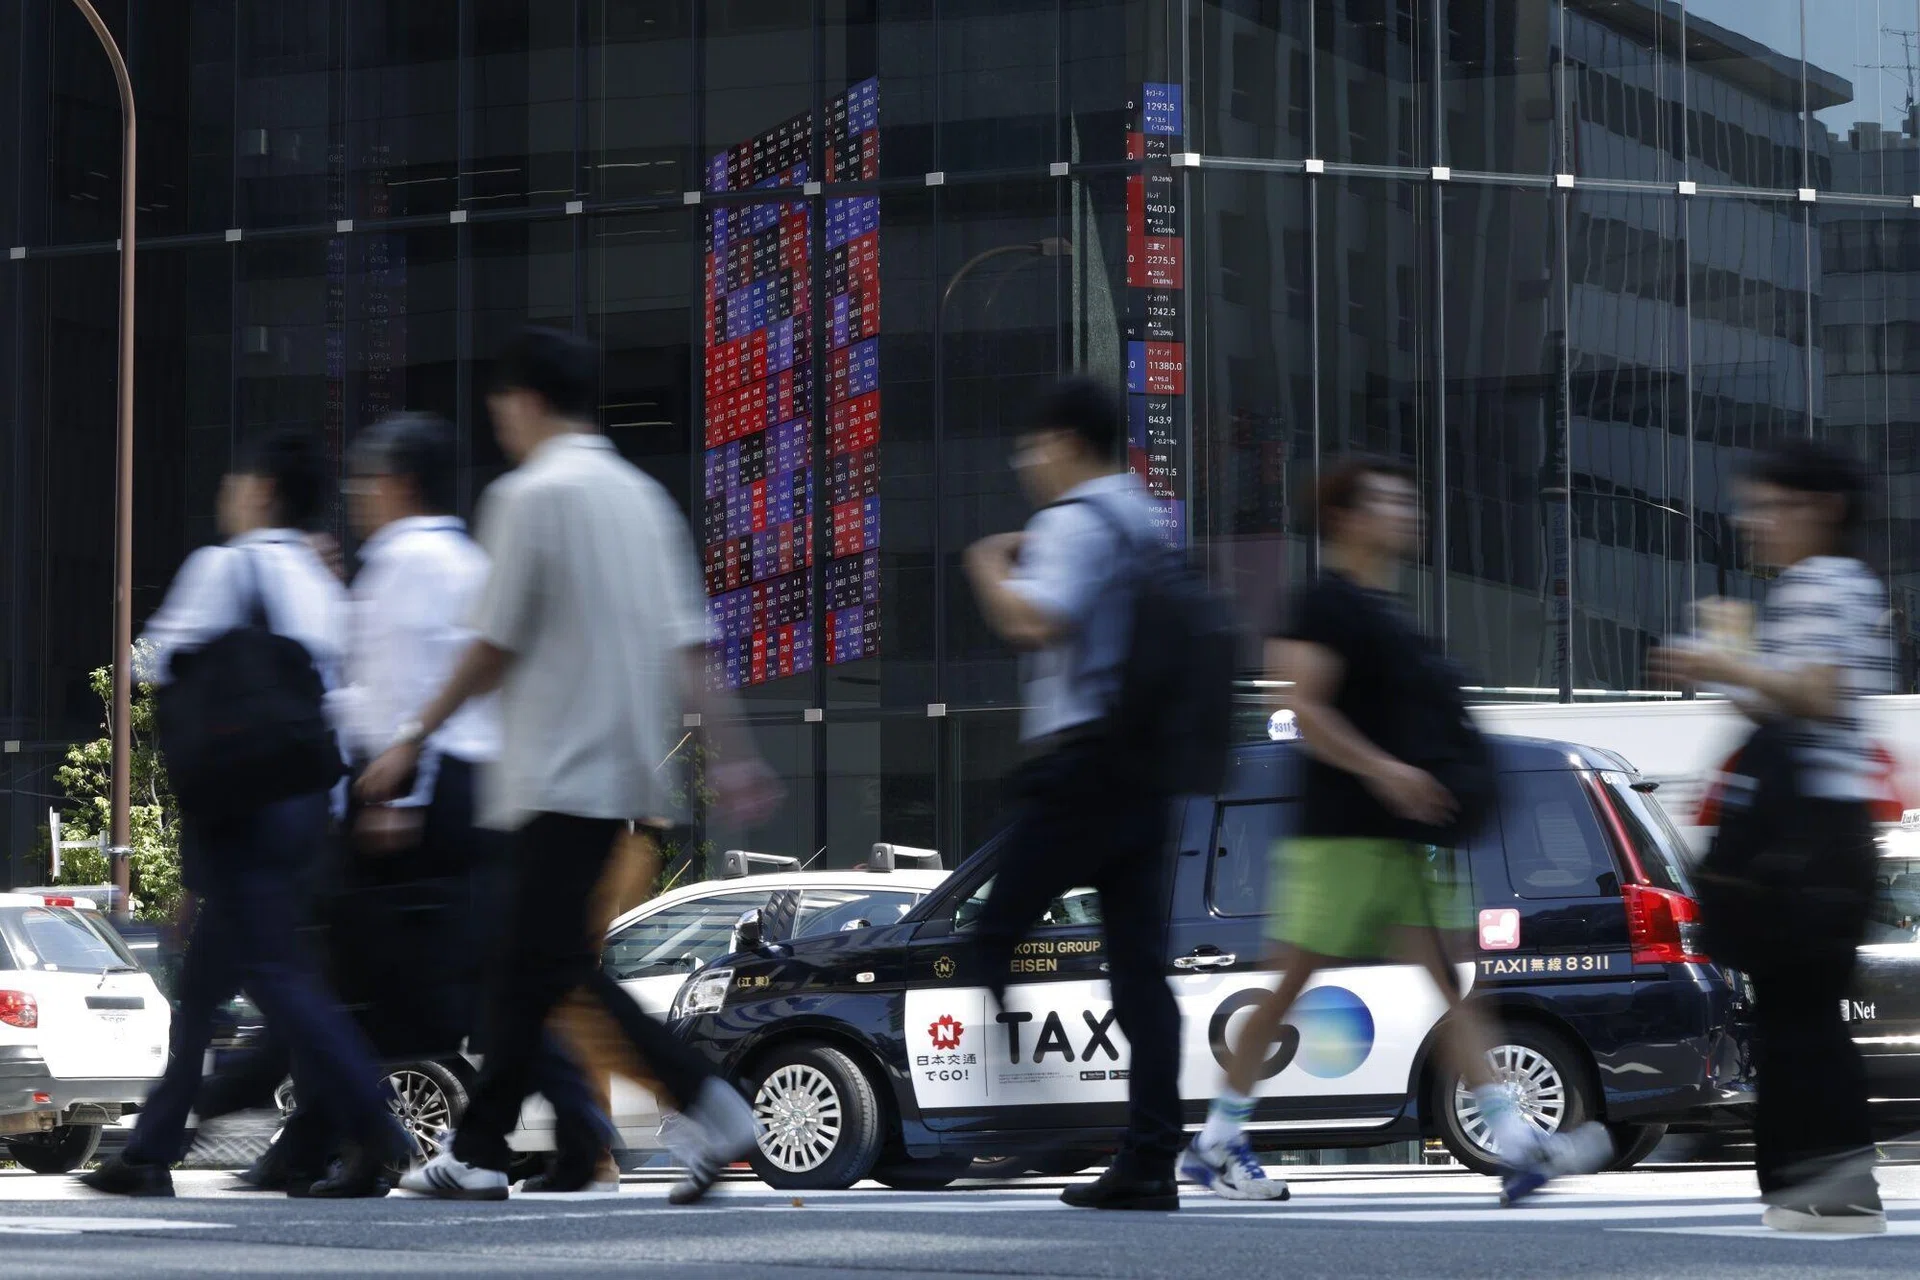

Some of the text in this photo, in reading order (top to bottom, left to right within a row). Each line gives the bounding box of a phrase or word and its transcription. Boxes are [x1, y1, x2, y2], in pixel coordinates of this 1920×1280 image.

[1146, 102, 1175, 112] 1293.5
[1146, 140, 1165, 149] デンカ
[1146, 204, 1176, 214] 9401.0
[1147, 255, 1176, 265] 2275.5
[1148, 307, 1176, 317] 1242.5
[1149, 361, 1183, 371] 11380.0
[1148, 415, 1172, 425] 843.9
[1148, 467, 1177, 477] 2991.5
[1057, 940, 1101, 953] GROUP
[1009, 958, 1059, 973] EISEN
[1852, 1000, 1877, 1020] Net
[995, 1008, 1121, 1066] TAX
[916, 1053, 978, 1067] 日本交通
[925, 1069, 969, 1082] でGO!
